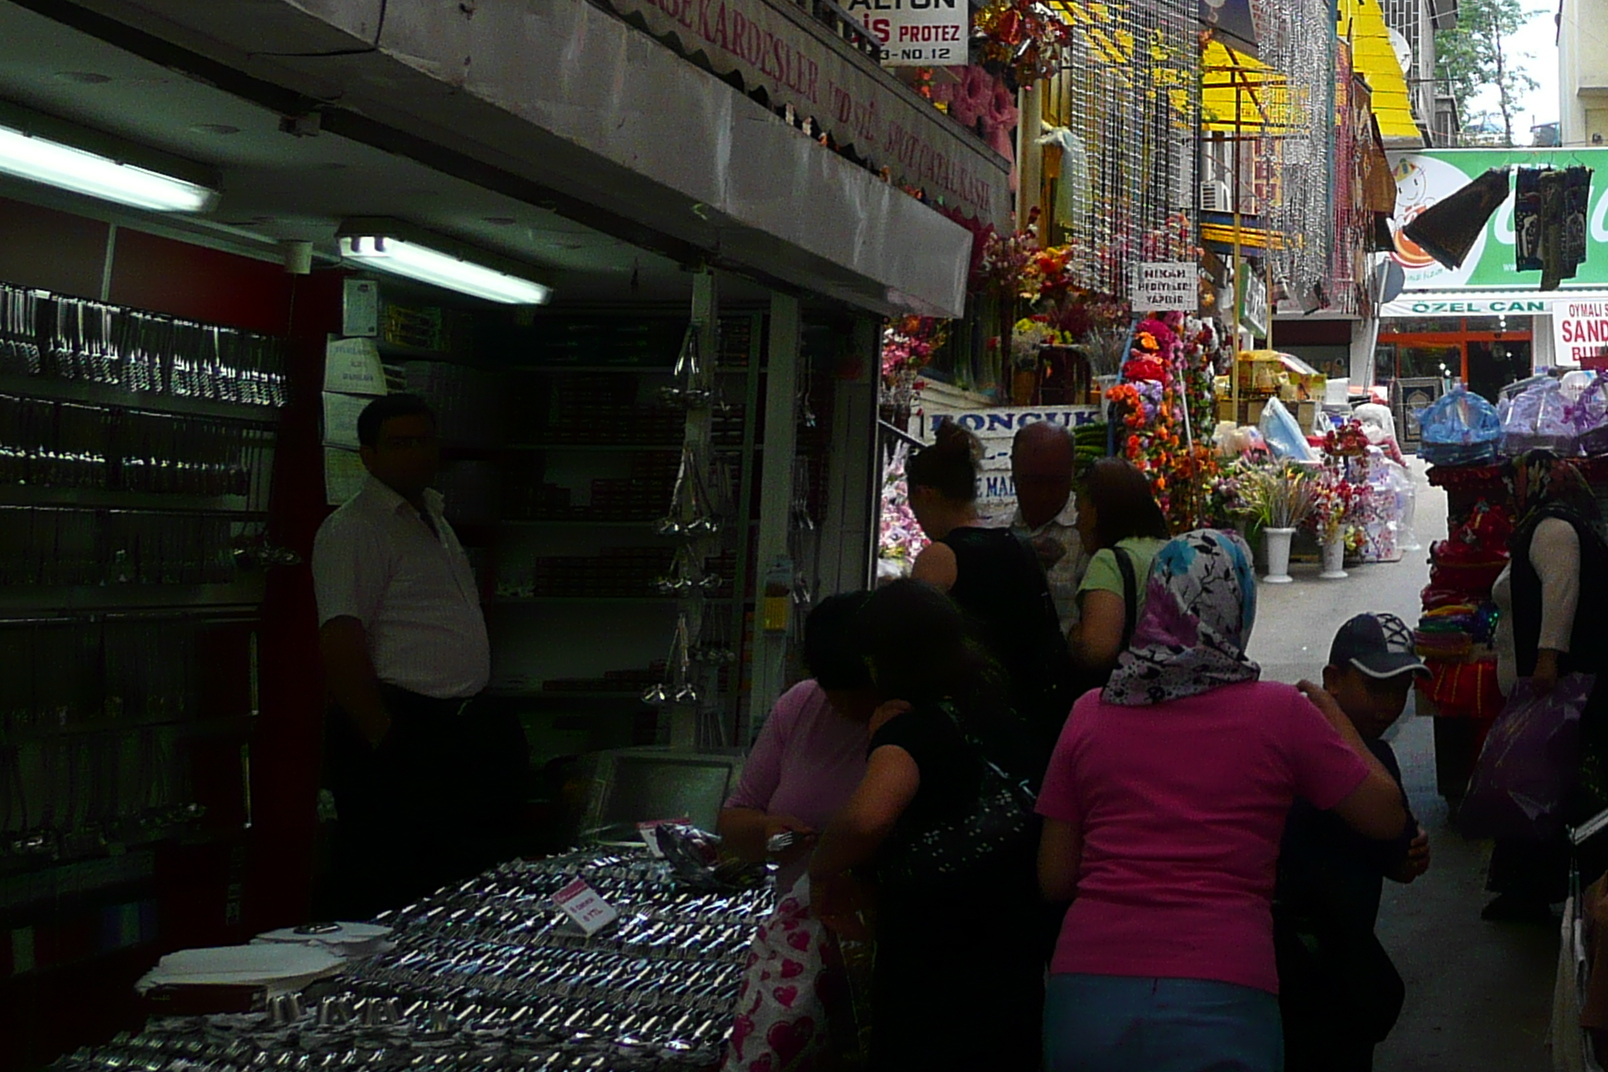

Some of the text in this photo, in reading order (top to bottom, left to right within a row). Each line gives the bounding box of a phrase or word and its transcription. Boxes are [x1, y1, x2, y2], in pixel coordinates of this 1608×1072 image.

[899, 25, 960, 42] PROTEZ
[1412, 300, 1544, 313] ÖZEL CAN
[1569, 303, 1603, 317] OYMALI
